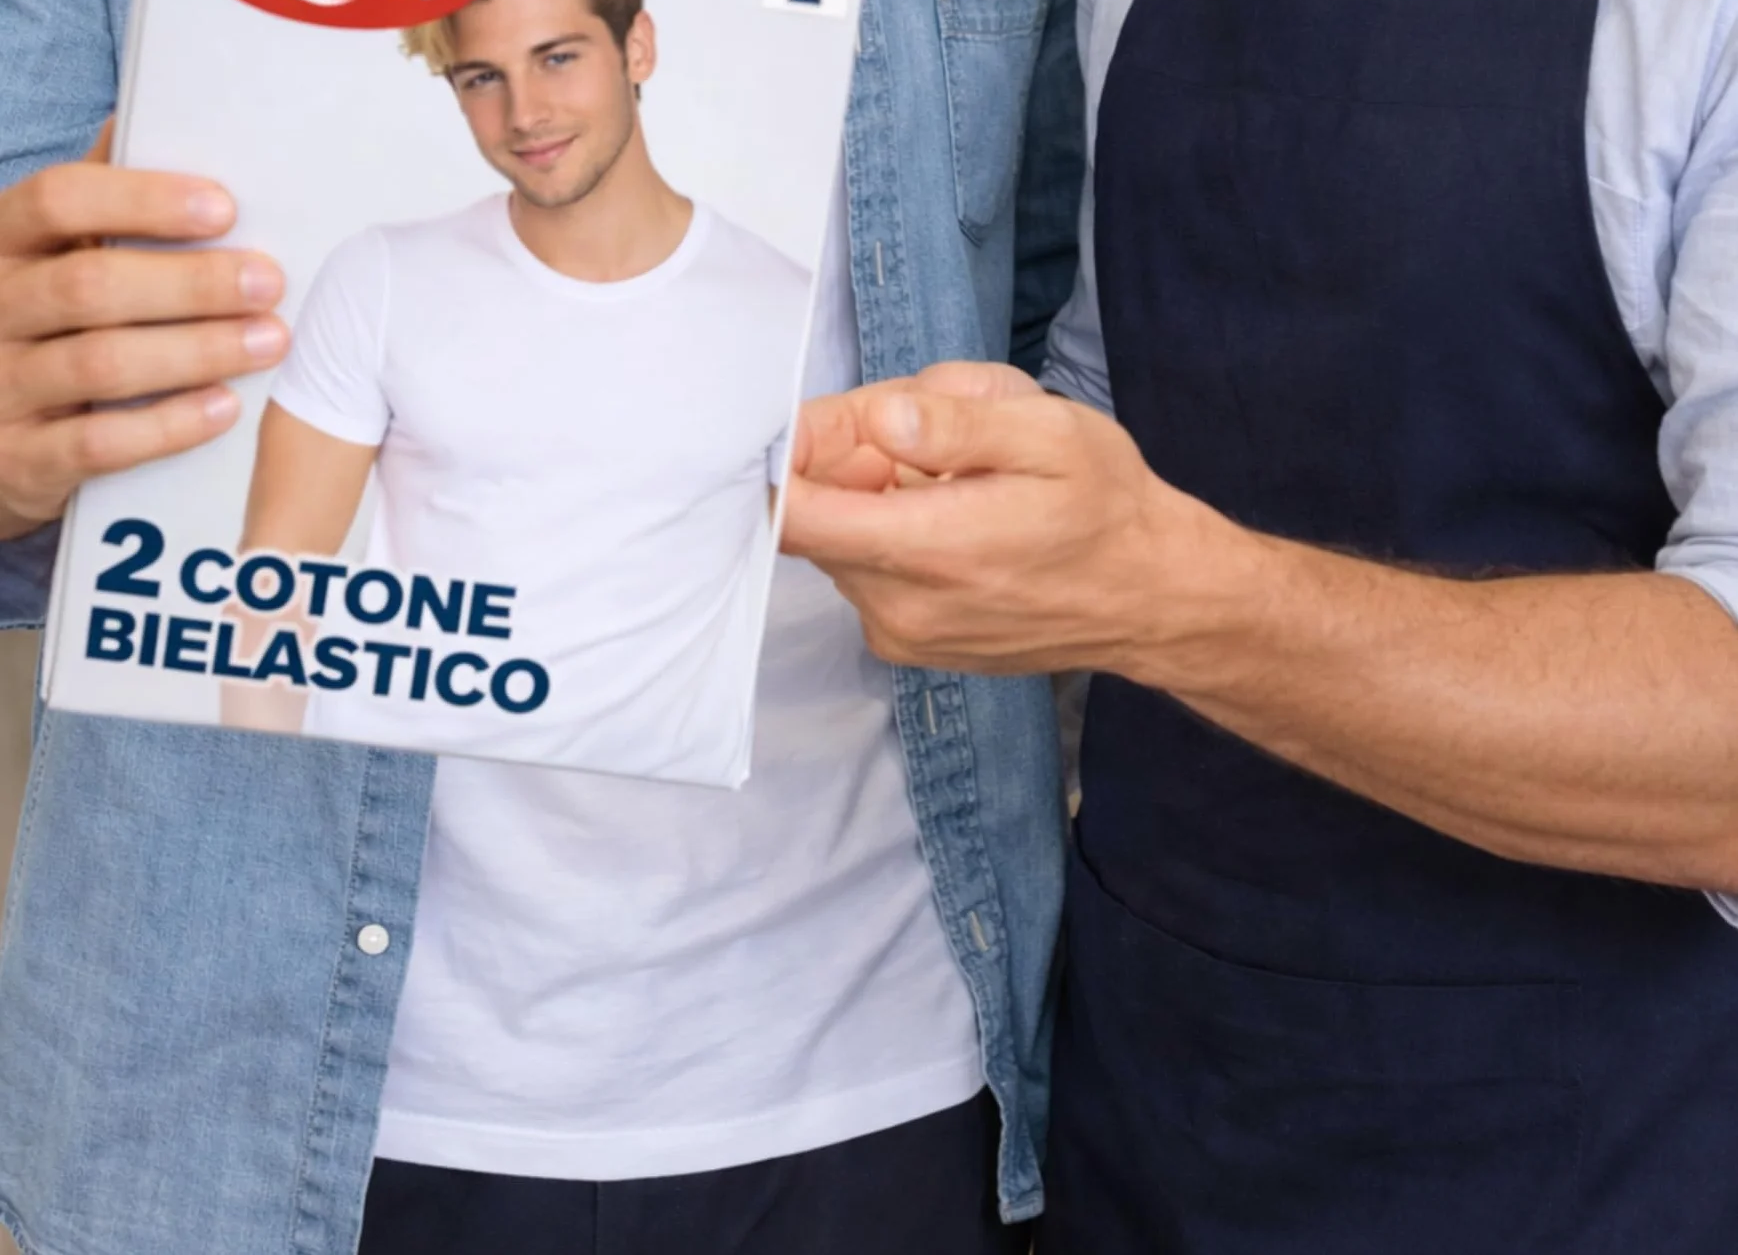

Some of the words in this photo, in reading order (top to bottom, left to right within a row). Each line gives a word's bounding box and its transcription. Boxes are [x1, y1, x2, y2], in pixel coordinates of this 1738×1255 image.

[95, 518, 165, 597] 2
[179, 548, 516, 639] COTONE
[85, 607, 550, 714] BIELASTICO
